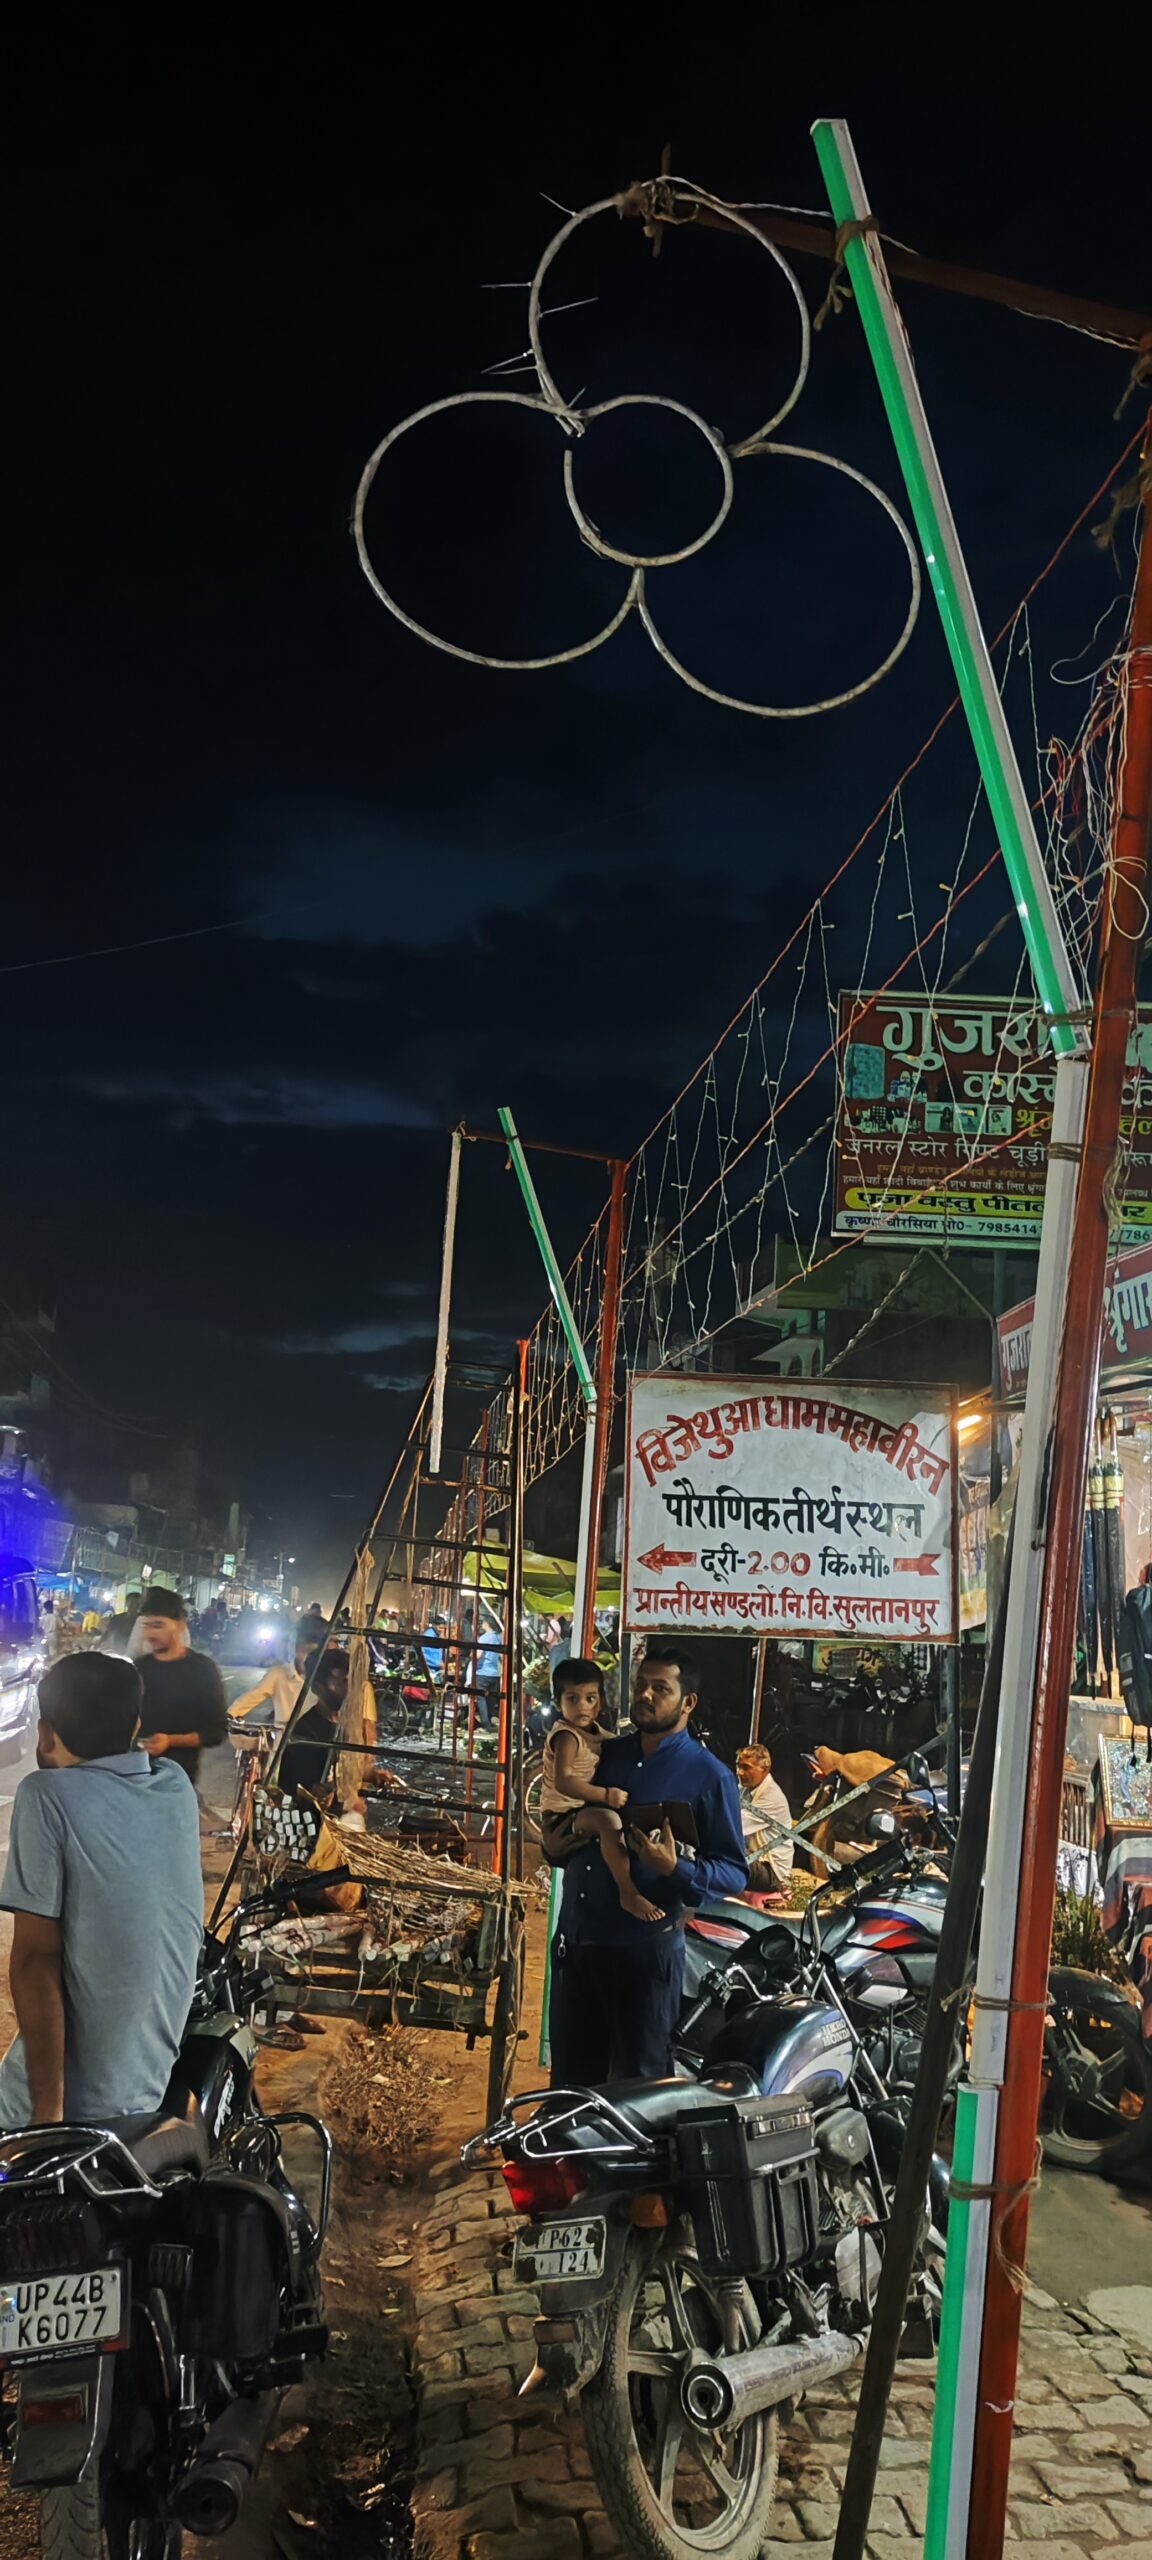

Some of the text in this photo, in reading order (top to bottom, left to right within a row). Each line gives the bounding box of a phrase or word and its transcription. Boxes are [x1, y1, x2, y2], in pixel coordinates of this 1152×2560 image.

[876, 1006, 1049, 1071] गुजरा
[908, 1136, 948, 1158] स्टोर
[978, 1222, 1043, 1234] 7985414
[662, 1477, 925, 1541] पौराणिक तीर्थ स्थल
[16, 2275, 104, 2314] UP44B
[18, 2306, 107, 2347] K6077
